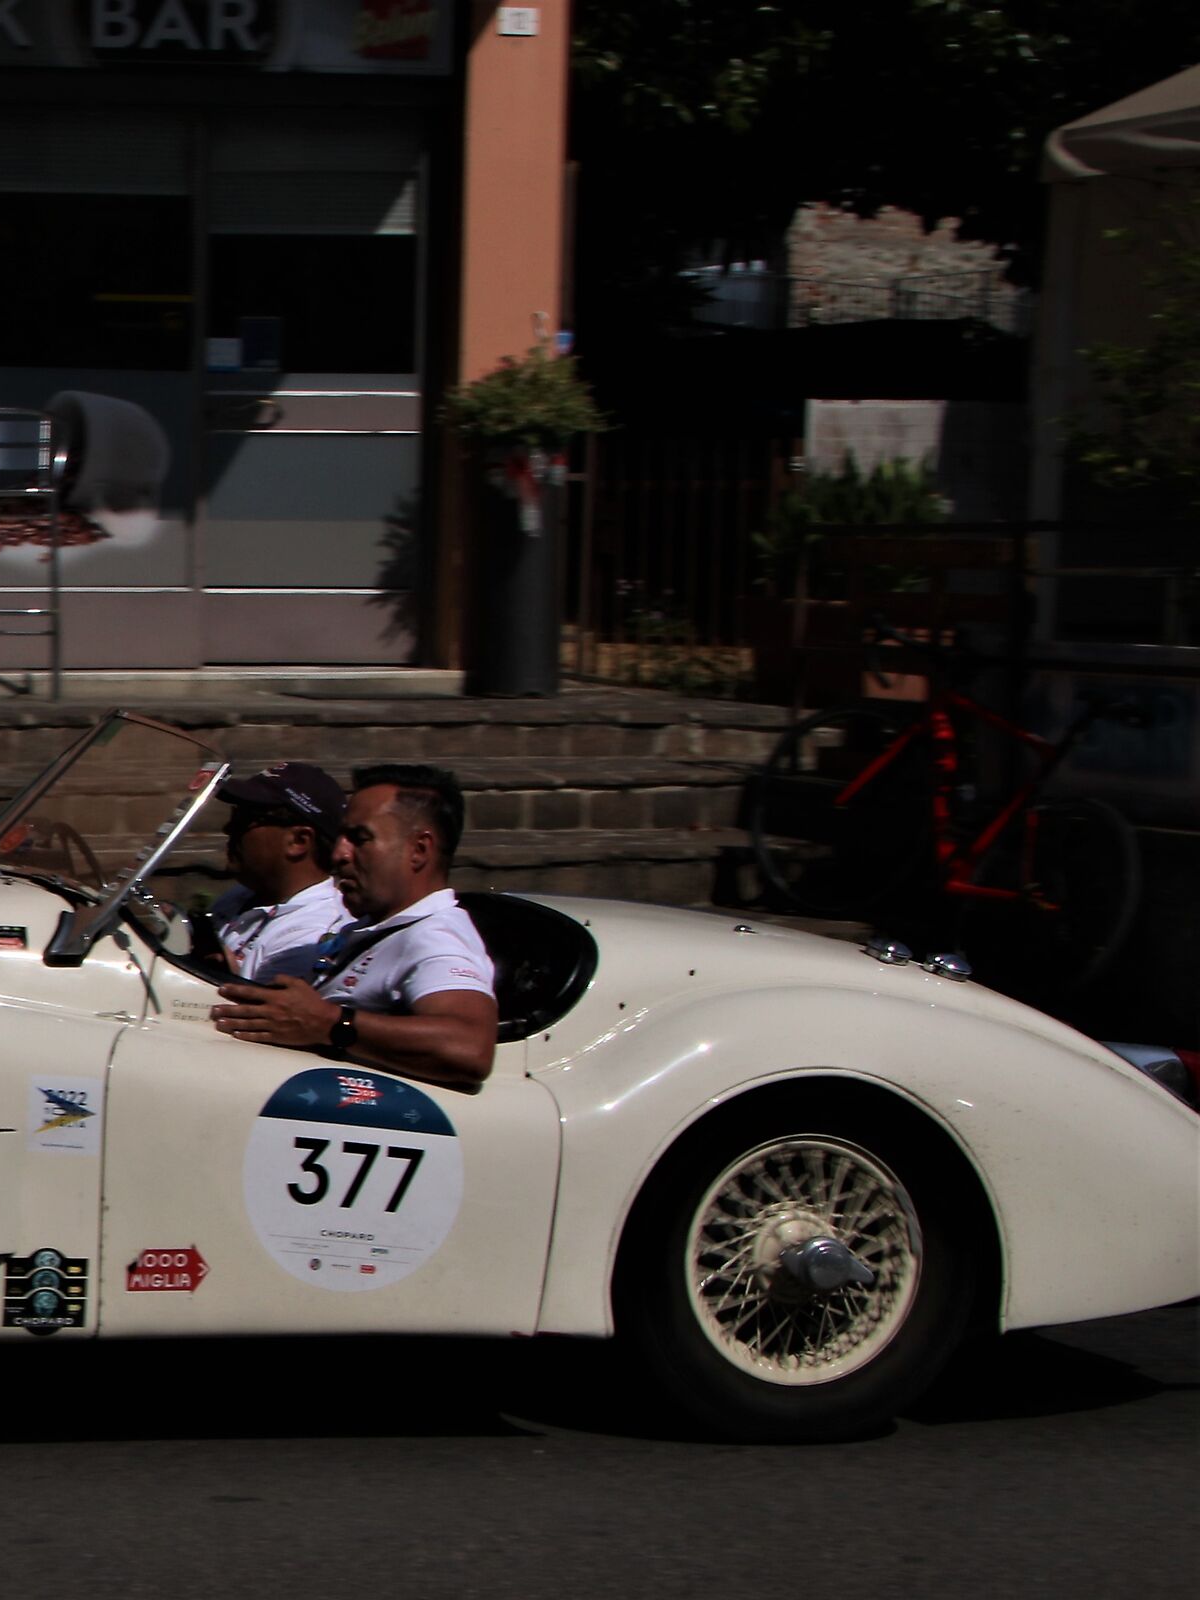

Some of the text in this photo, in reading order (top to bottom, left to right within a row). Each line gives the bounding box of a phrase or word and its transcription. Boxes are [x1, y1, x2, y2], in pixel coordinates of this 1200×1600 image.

[90, 0, 262, 51] BAR
[336, 1074, 376, 1090] 2022
[287, 1136, 425, 1213] 377
[320, 1229, 375, 1241] CHOPARD
[129, 1272, 192, 1288] MIGLIA
[12, 1316, 75, 1325] CHOPARD
